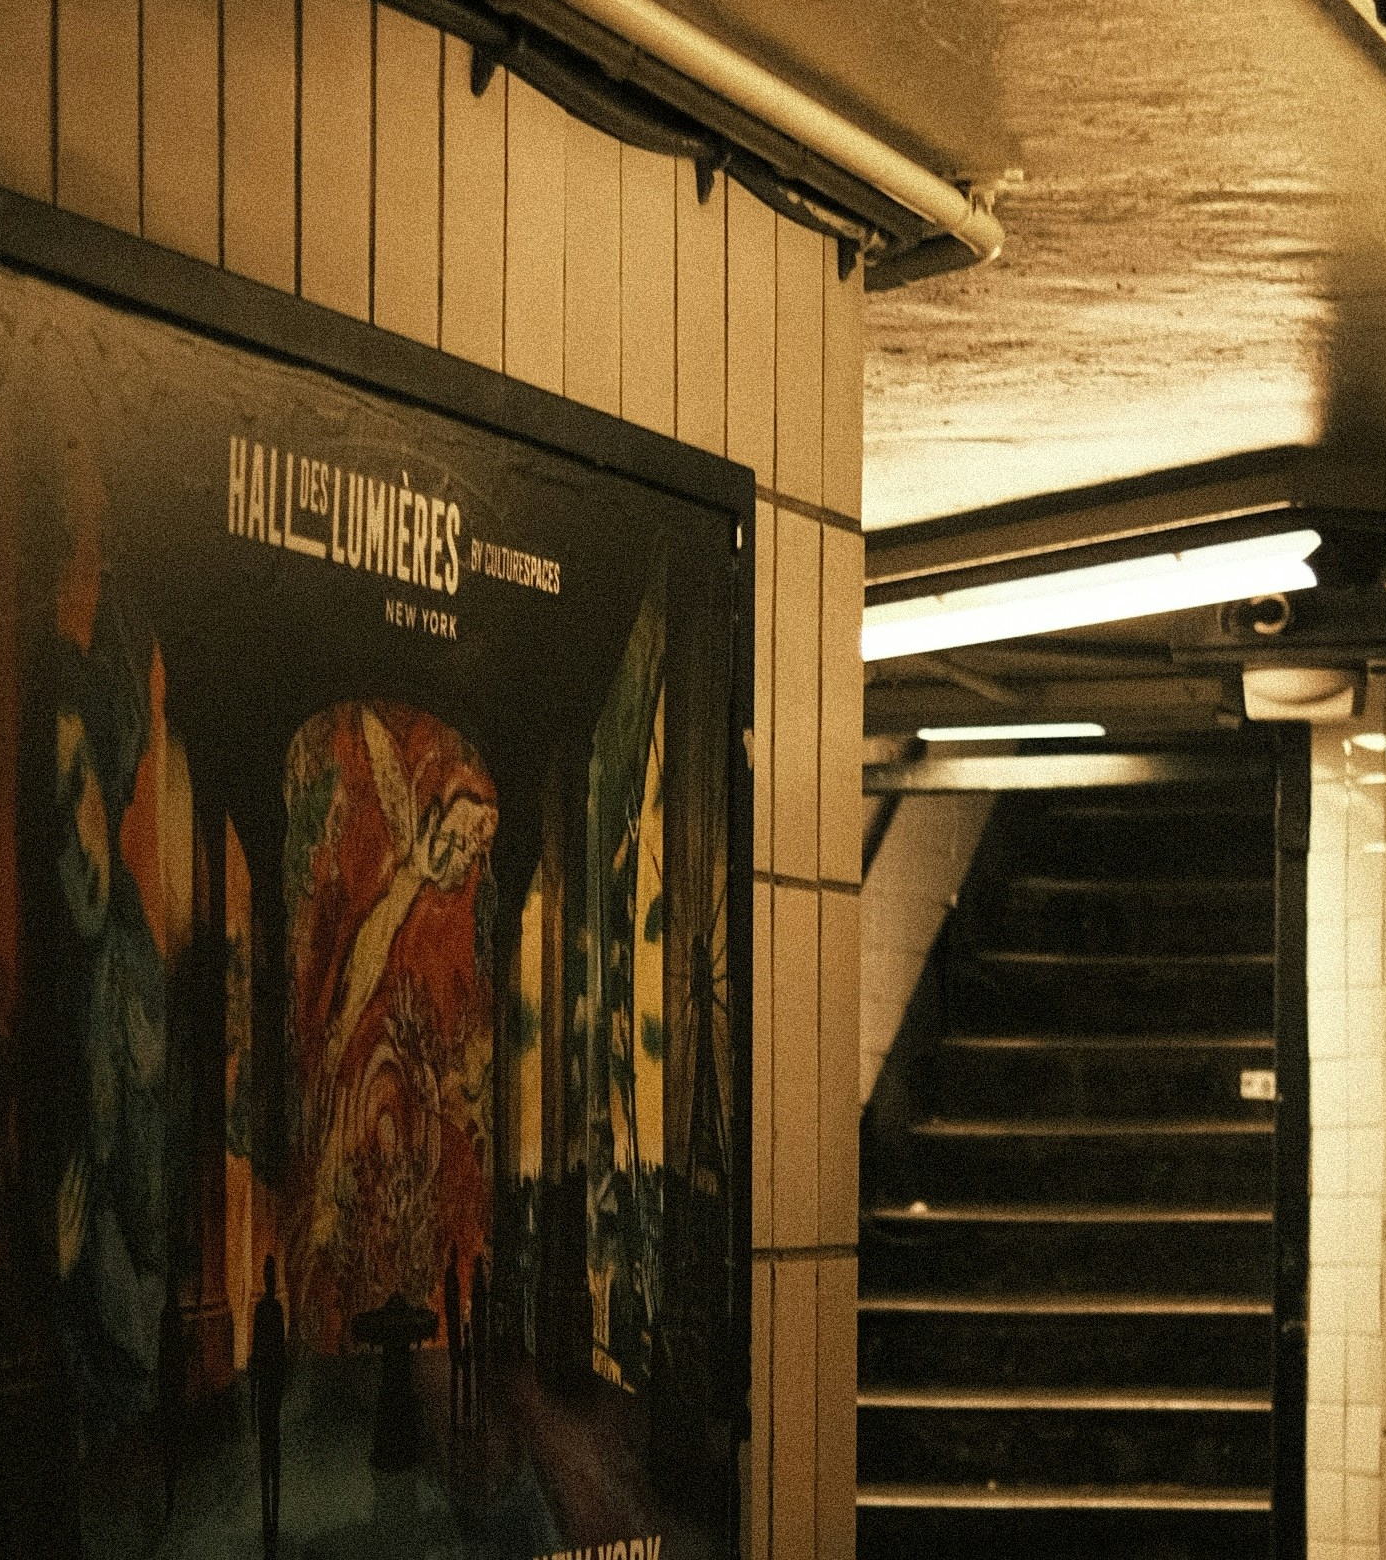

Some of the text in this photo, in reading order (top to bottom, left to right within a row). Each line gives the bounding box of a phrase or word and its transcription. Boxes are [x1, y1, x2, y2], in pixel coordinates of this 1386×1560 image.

[229, 436, 560, 596] HALL DES LUMIÈRES BY CULTURESPACES
[385, 599, 458, 640] NEW YORK
